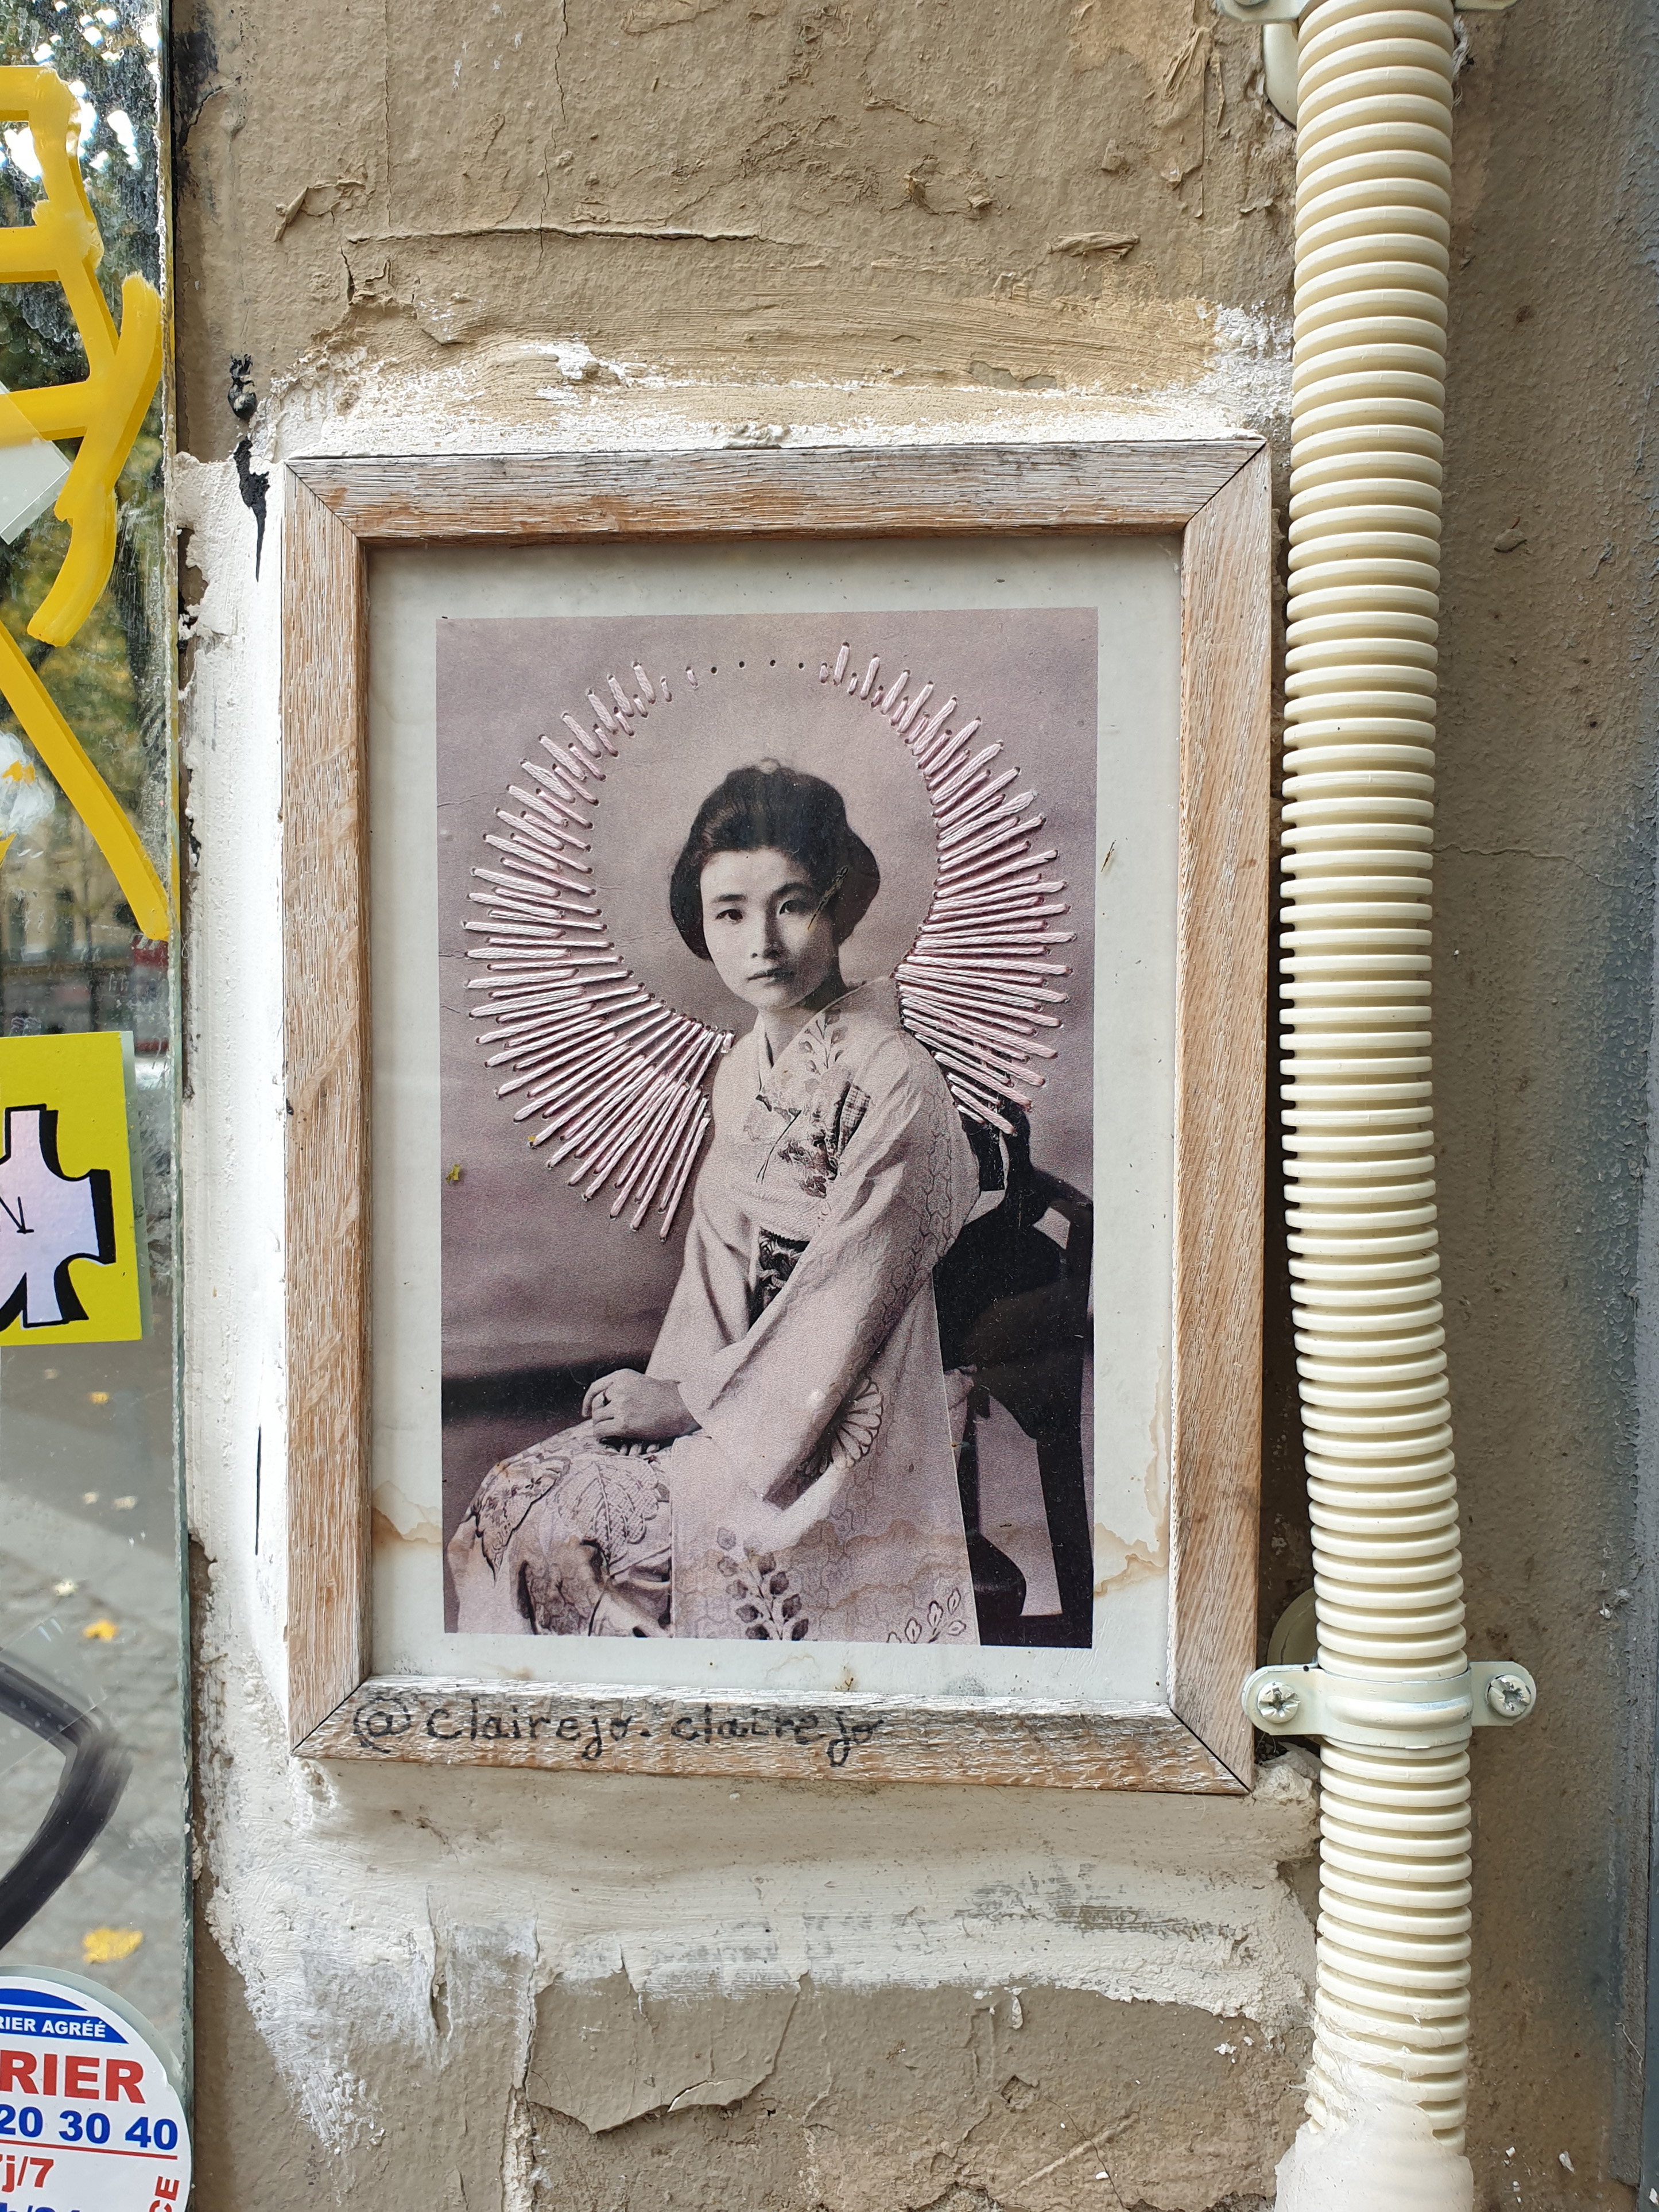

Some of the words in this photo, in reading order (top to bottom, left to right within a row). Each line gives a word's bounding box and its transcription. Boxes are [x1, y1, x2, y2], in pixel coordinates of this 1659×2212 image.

[41, 2019, 106, 2038] AGRÉÉ
[0, 2103, 43, 2138] 20
[59, 2110, 110, 2144] 30
[125, 2117, 178, 2151] 40
[0, 2154, 55, 2192] j/7
